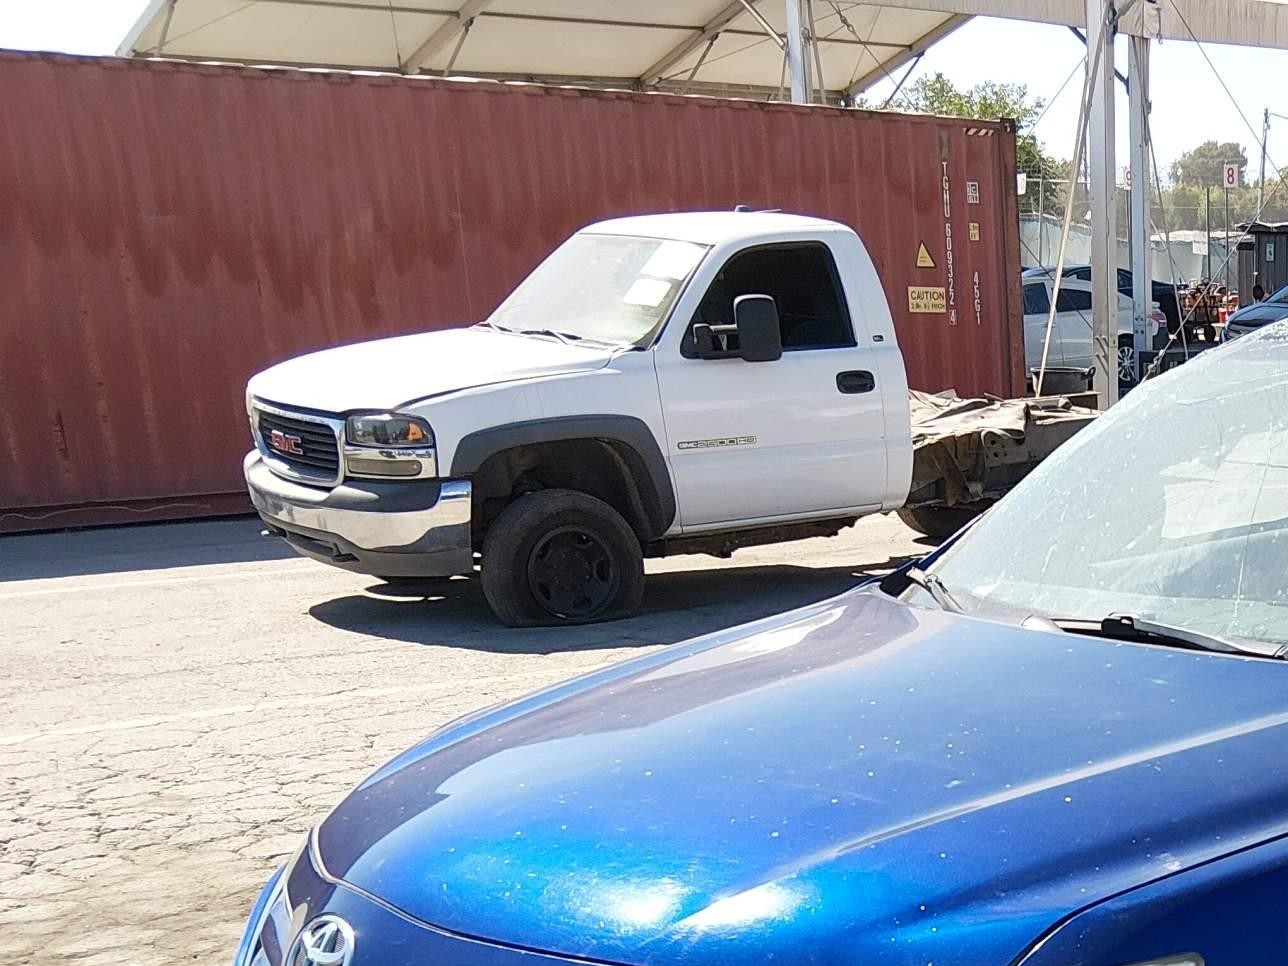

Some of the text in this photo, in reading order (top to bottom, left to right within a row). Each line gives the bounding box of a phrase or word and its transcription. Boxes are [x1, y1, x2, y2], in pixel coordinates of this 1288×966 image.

[942, 161, 951, 218] TGHU
[1227, 167, 1235, 185] 8
[945, 223, 955, 306] 609322
[911, 290, 945, 301] CAUTION
[973, 271, 981, 325] 45G1
[271, 430, 304, 455] GMC
